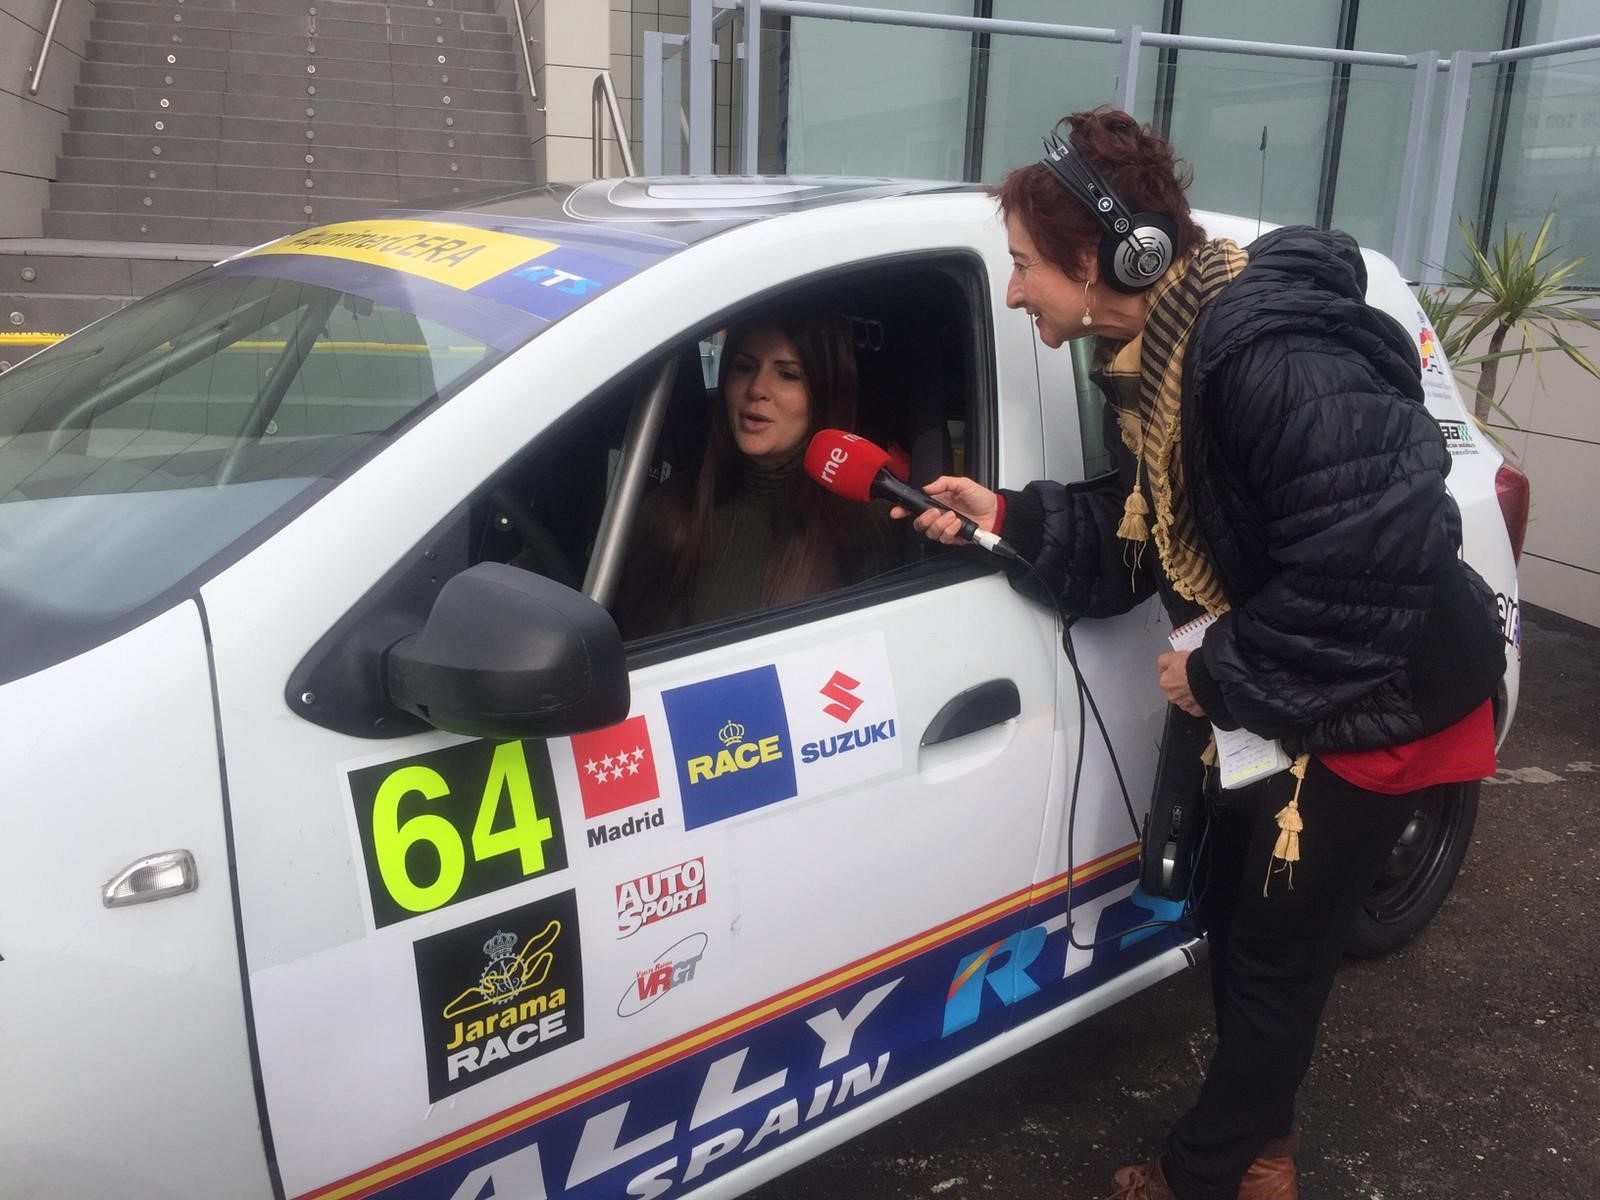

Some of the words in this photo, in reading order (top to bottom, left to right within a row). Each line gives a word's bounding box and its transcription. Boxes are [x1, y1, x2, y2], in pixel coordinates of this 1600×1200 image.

[819, 447, 849, 484] rne
[687, 735, 783, 784] RACE
[801, 718, 896, 764] SUZUKI
[373, 739, 553, 912] 64
[587, 808, 665, 848] Madrid
[617, 883, 704, 940] SPORT
[618, 859, 704, 913] AUTO
[636, 953, 703, 1001] VRGT
[446, 988, 566, 1050] Jarama
[447, 1009, 567, 1082] RACE
[626, 1052, 891, 1200] SPAIN
